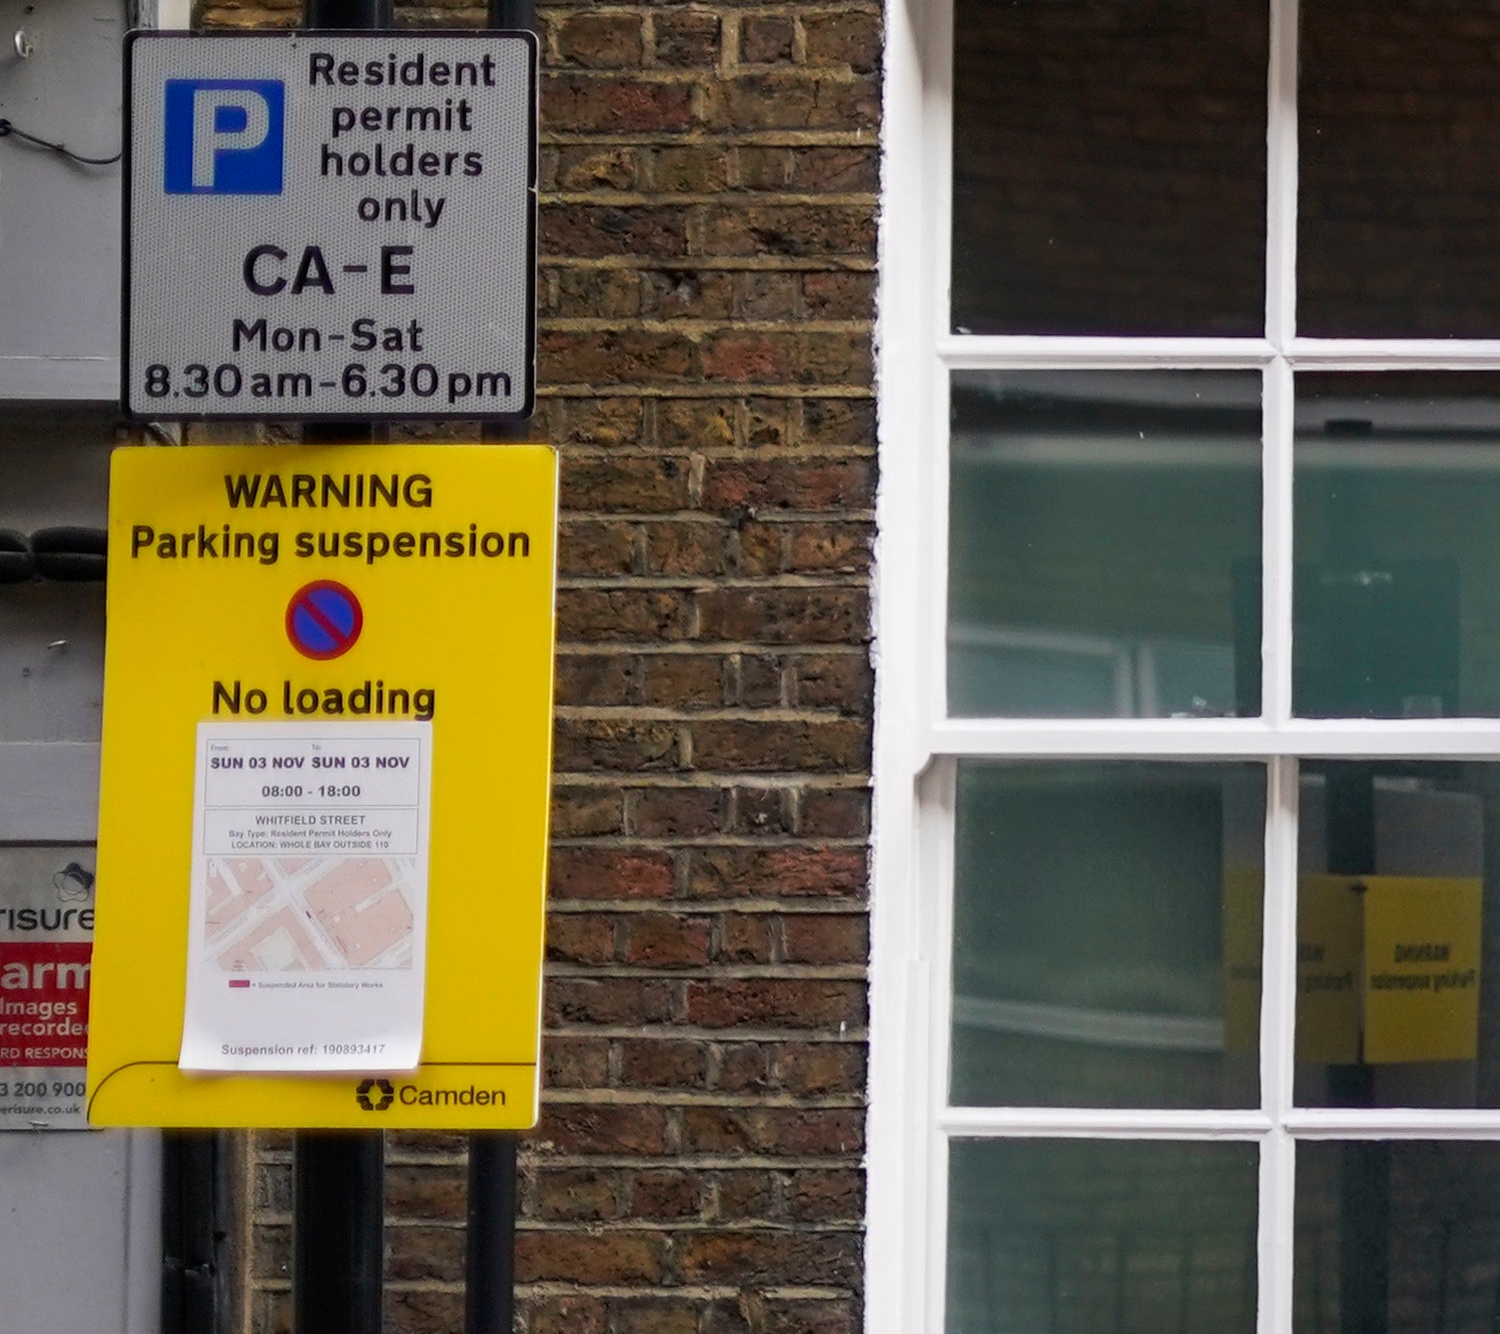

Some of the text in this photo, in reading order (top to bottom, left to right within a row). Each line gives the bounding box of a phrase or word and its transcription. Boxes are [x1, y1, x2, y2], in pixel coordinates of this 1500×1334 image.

[308, 53, 496, 86] Resident
[331, 99, 473, 137] permit
[192, 89, 270, 186] P
[320, 144, 484, 177] holders
[357, 189, 447, 229] only
[231, 319, 424, 353] Mon-Sat
[223, 474, 433, 509] WARNING
[131, 523, 531, 566] Parking suspension
[212, 680, 435, 721] No loading
[210, 757, 305, 769] SUN 03 NOV
[311, 756, 410, 769] SUN 03 NOV
[262, 785, 303, 797] 08:00
[318, 785, 361, 797] 18:00
[255, 815, 366, 825] WHITFIELD STREET
[229, 830, 244, 838] Bay
[373, 829, 392, 838] Only
[231, 841, 277, 849] LOCATION:
[280, 841, 311, 849] WHOLE
[314, 841, 330, 849] BAY
[0, 909, 95, 931] isure
[0, 962, 91, 990] arm
[0, 1017, 89, 1036] recorde
[0, 1047, 20, 1059] RD
[221, 1043, 387, 1058] Suspension ref: 190893417
[14, 1082, 48, 1097] 200
[53, 1082, 86, 1097] 900
[399, 1085, 506, 1106] Camden
[0, 1103, 80, 1115] erisure.co.uk
